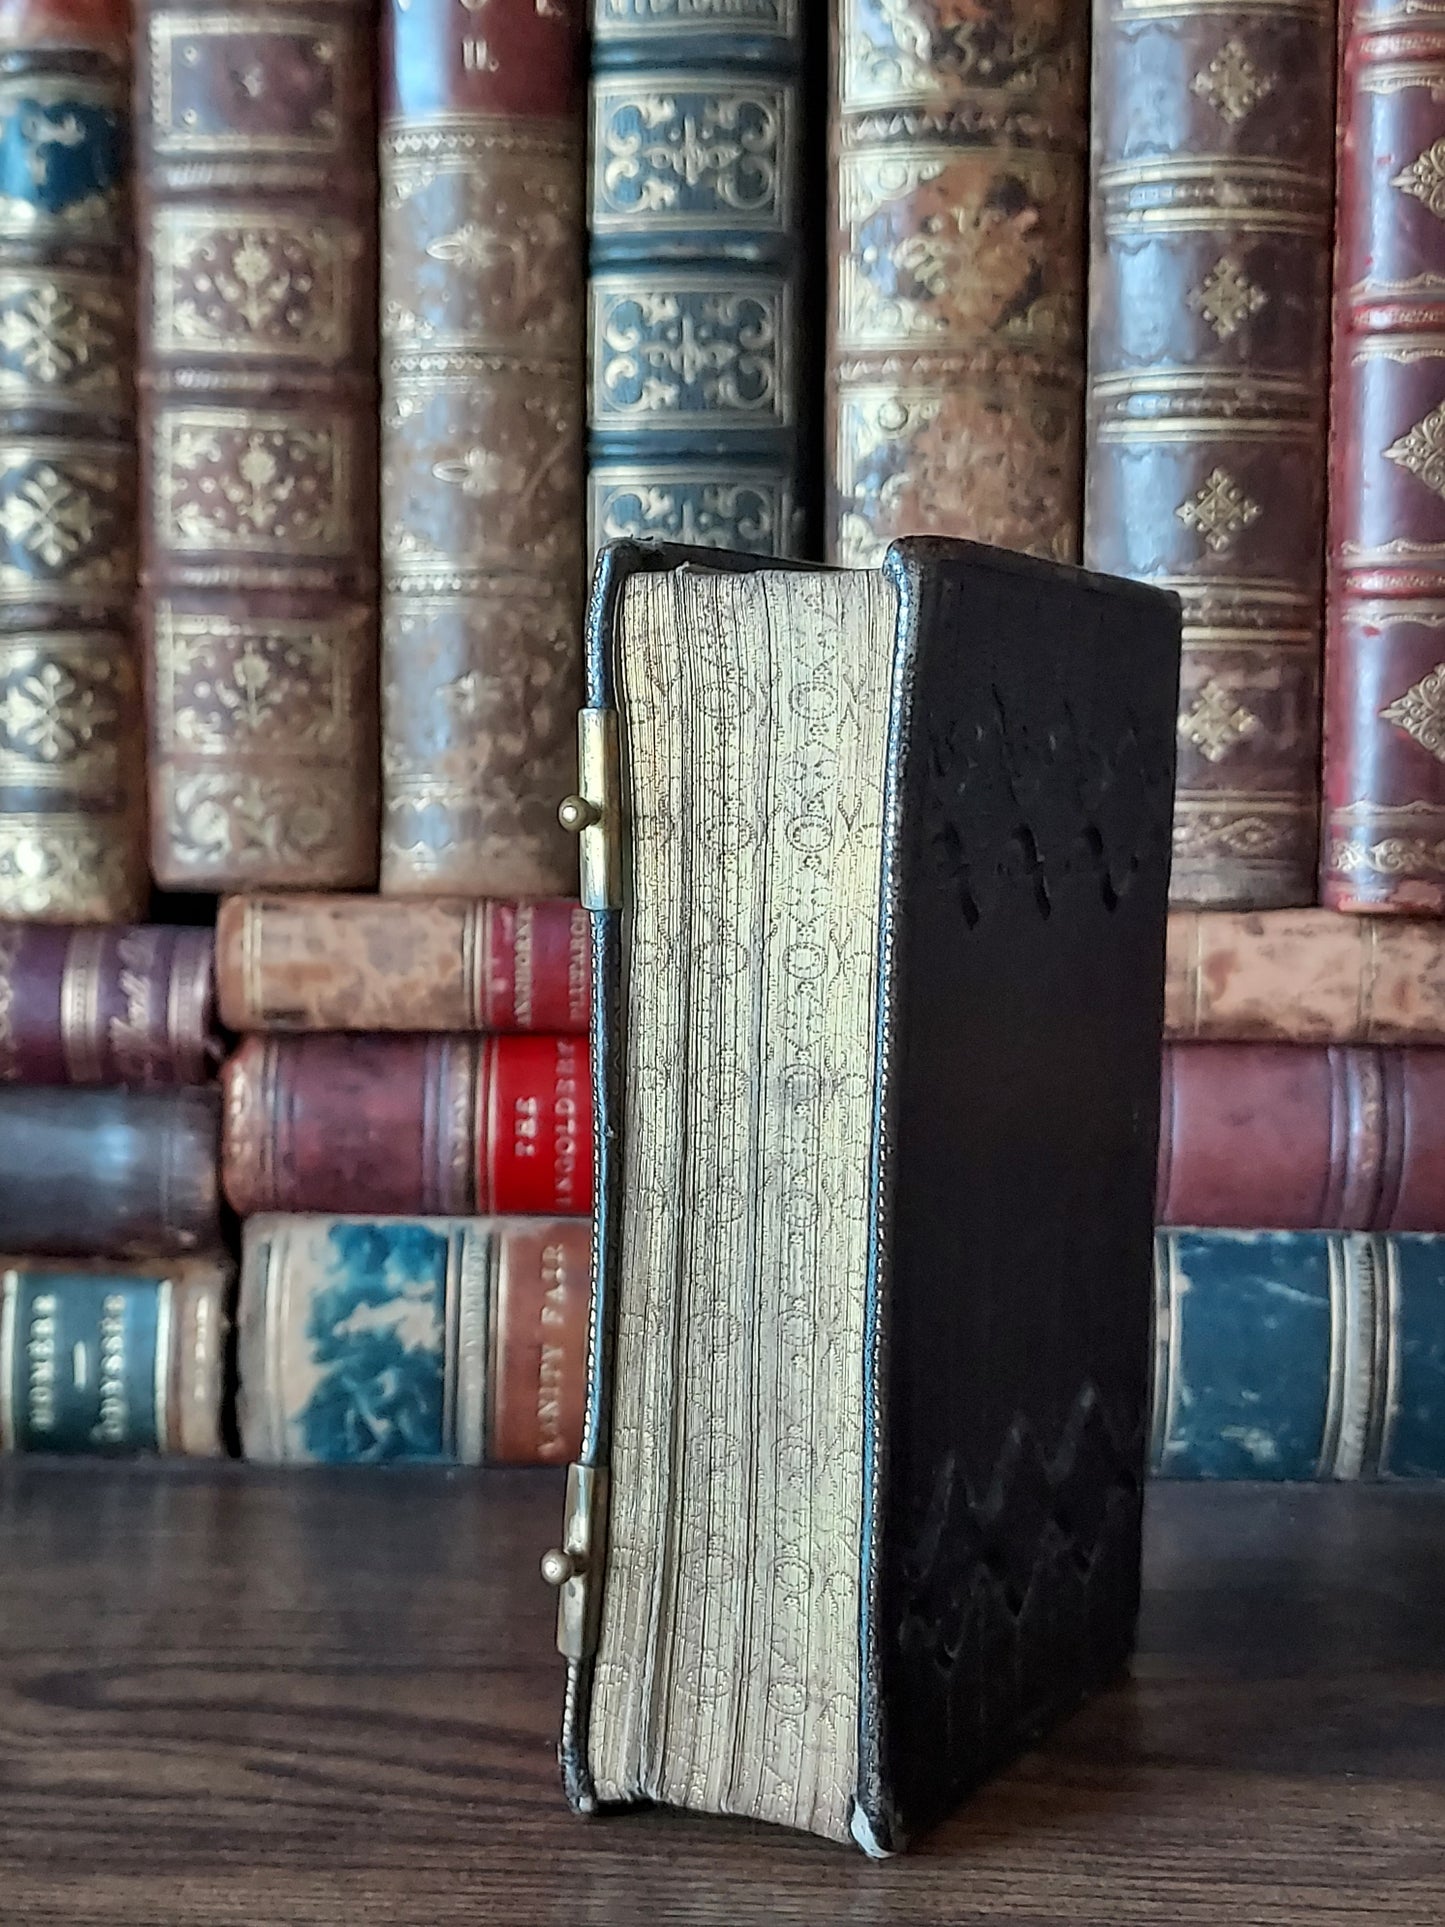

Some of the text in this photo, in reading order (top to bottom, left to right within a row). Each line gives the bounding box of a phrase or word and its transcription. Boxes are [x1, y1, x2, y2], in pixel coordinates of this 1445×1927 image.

[553, 1041, 577, 1207] INGOLDSBY
[536, 1244, 567, 1456] VANITY FAIR
